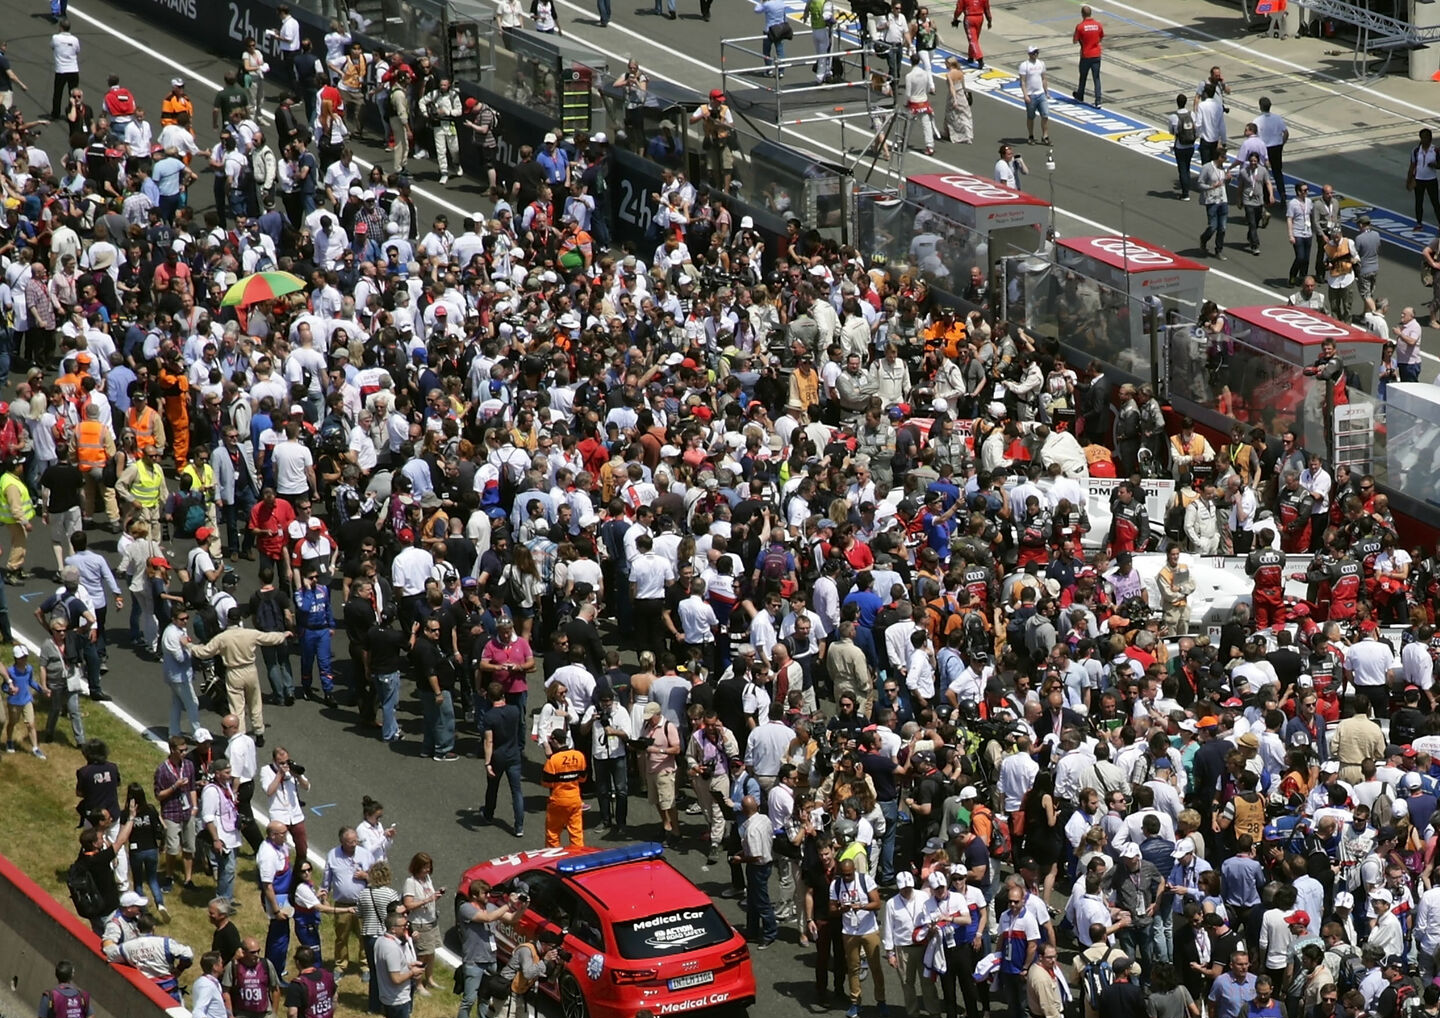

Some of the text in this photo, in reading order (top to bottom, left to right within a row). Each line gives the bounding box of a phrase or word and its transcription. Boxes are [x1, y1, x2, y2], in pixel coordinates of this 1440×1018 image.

[618, 179, 652, 232] 24h
[1208, 626, 1219, 635] P1
[1247, 822, 1259, 834] 28
[633, 911, 704, 932] Medical Car
[665, 924, 694, 936] ACTION
[499, 921, 527, 944] edical
[660, 992, 729, 1014] Medical Car
